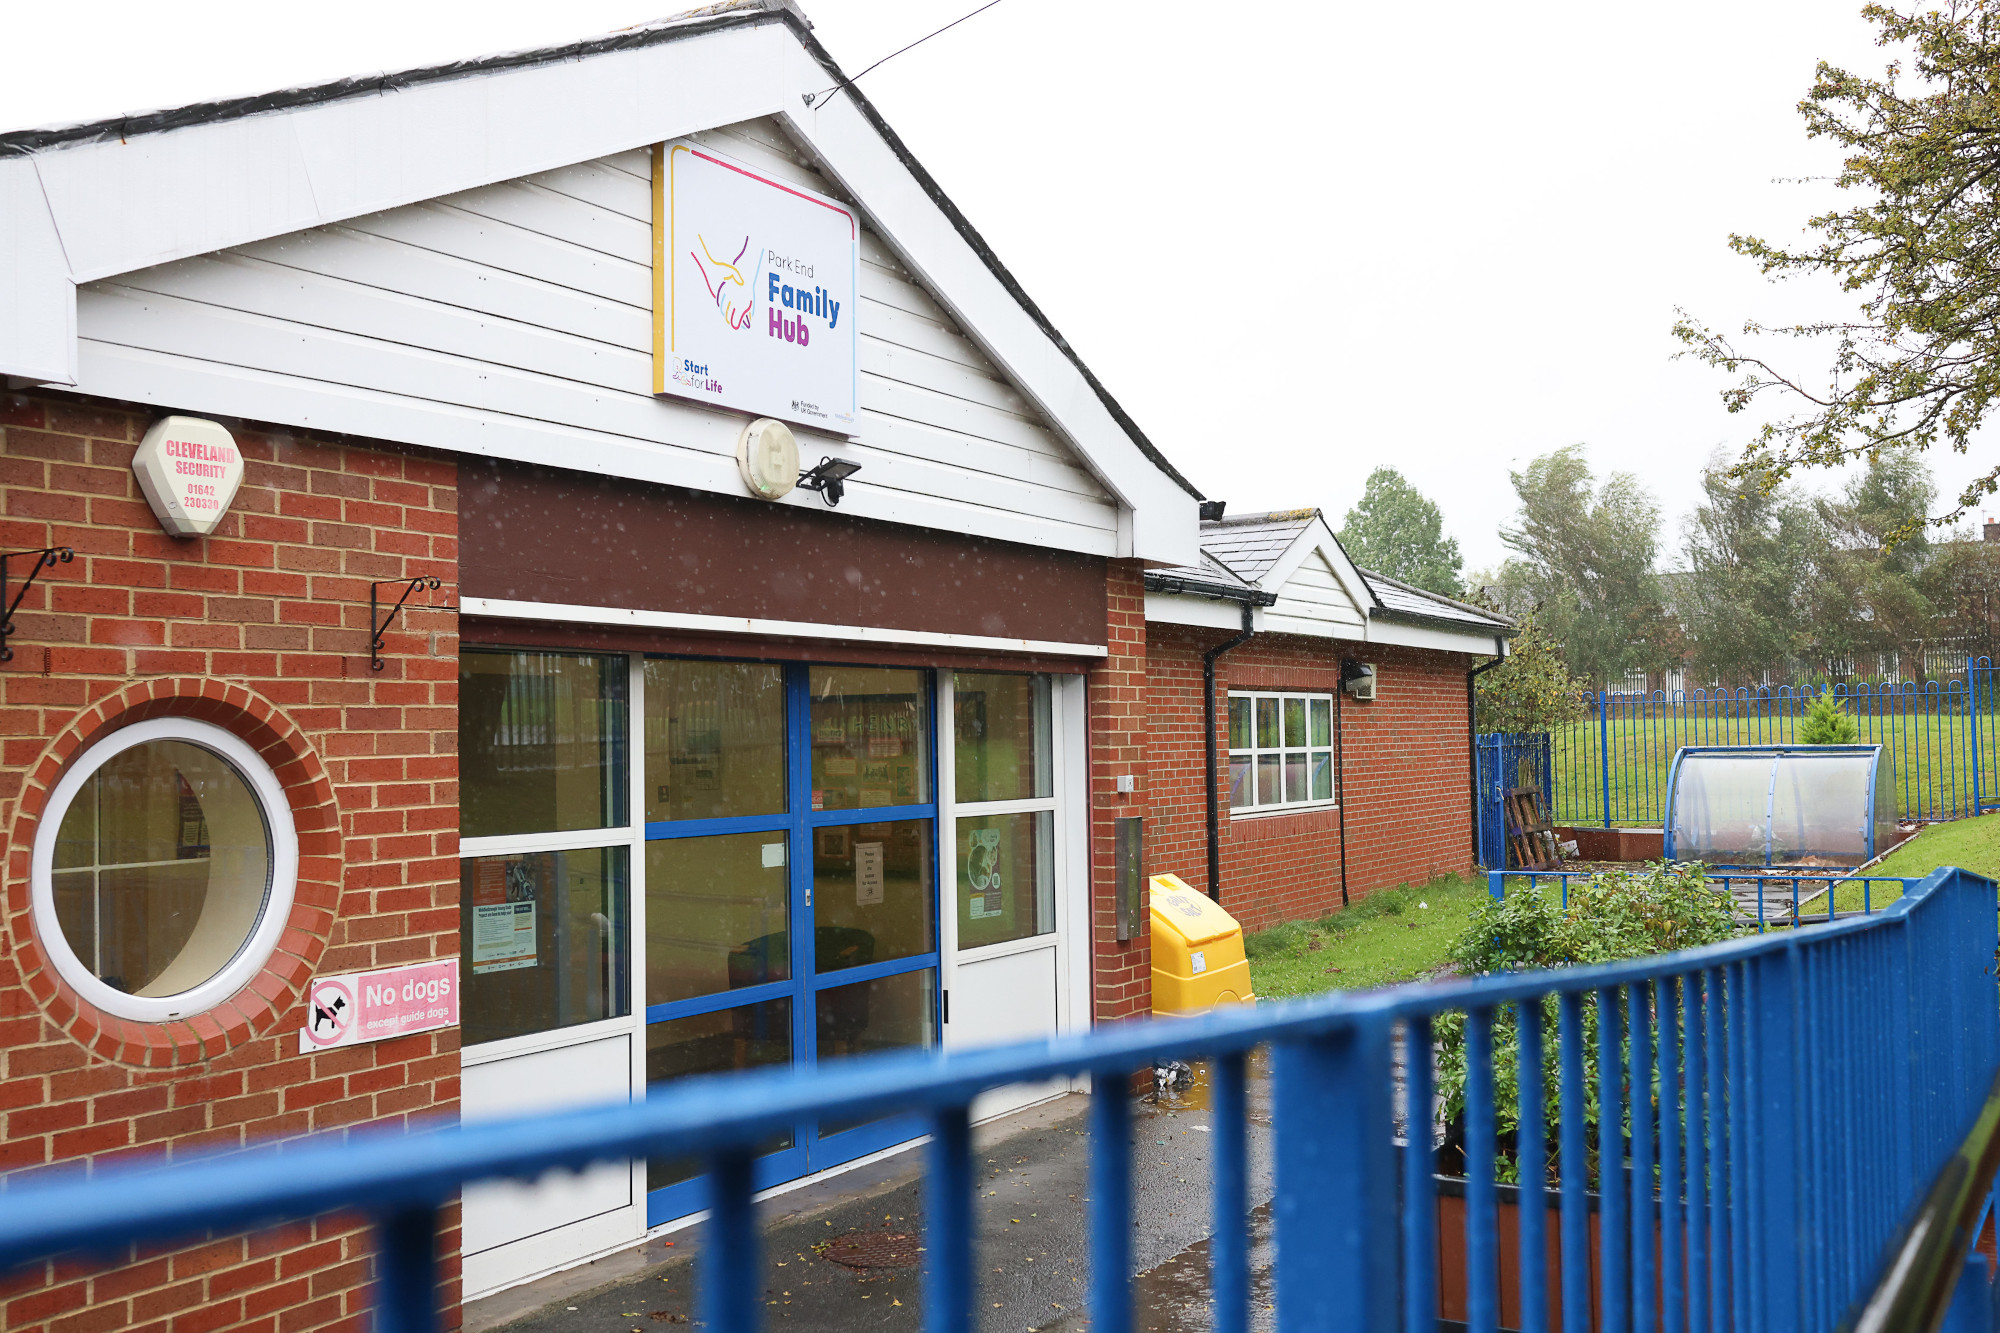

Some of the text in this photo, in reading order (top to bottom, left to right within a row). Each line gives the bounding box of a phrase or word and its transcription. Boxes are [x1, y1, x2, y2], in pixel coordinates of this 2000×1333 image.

[768, 249, 814, 279] Park End
[768, 271, 840, 329] Family
[768, 306, 809, 347] Hub
[684, 359, 708, 376] Start
[691, 374, 723, 394] for Life
[166, 440, 235, 464] CLEVELAND
[175, 460, 226, 479] SECURITY
[187, 483, 215, 496] 01642
[184, 496, 219, 510] 230330
[366, 977, 451, 1008] No dogs
[366, 1006, 449, 1030] except guide dogs
